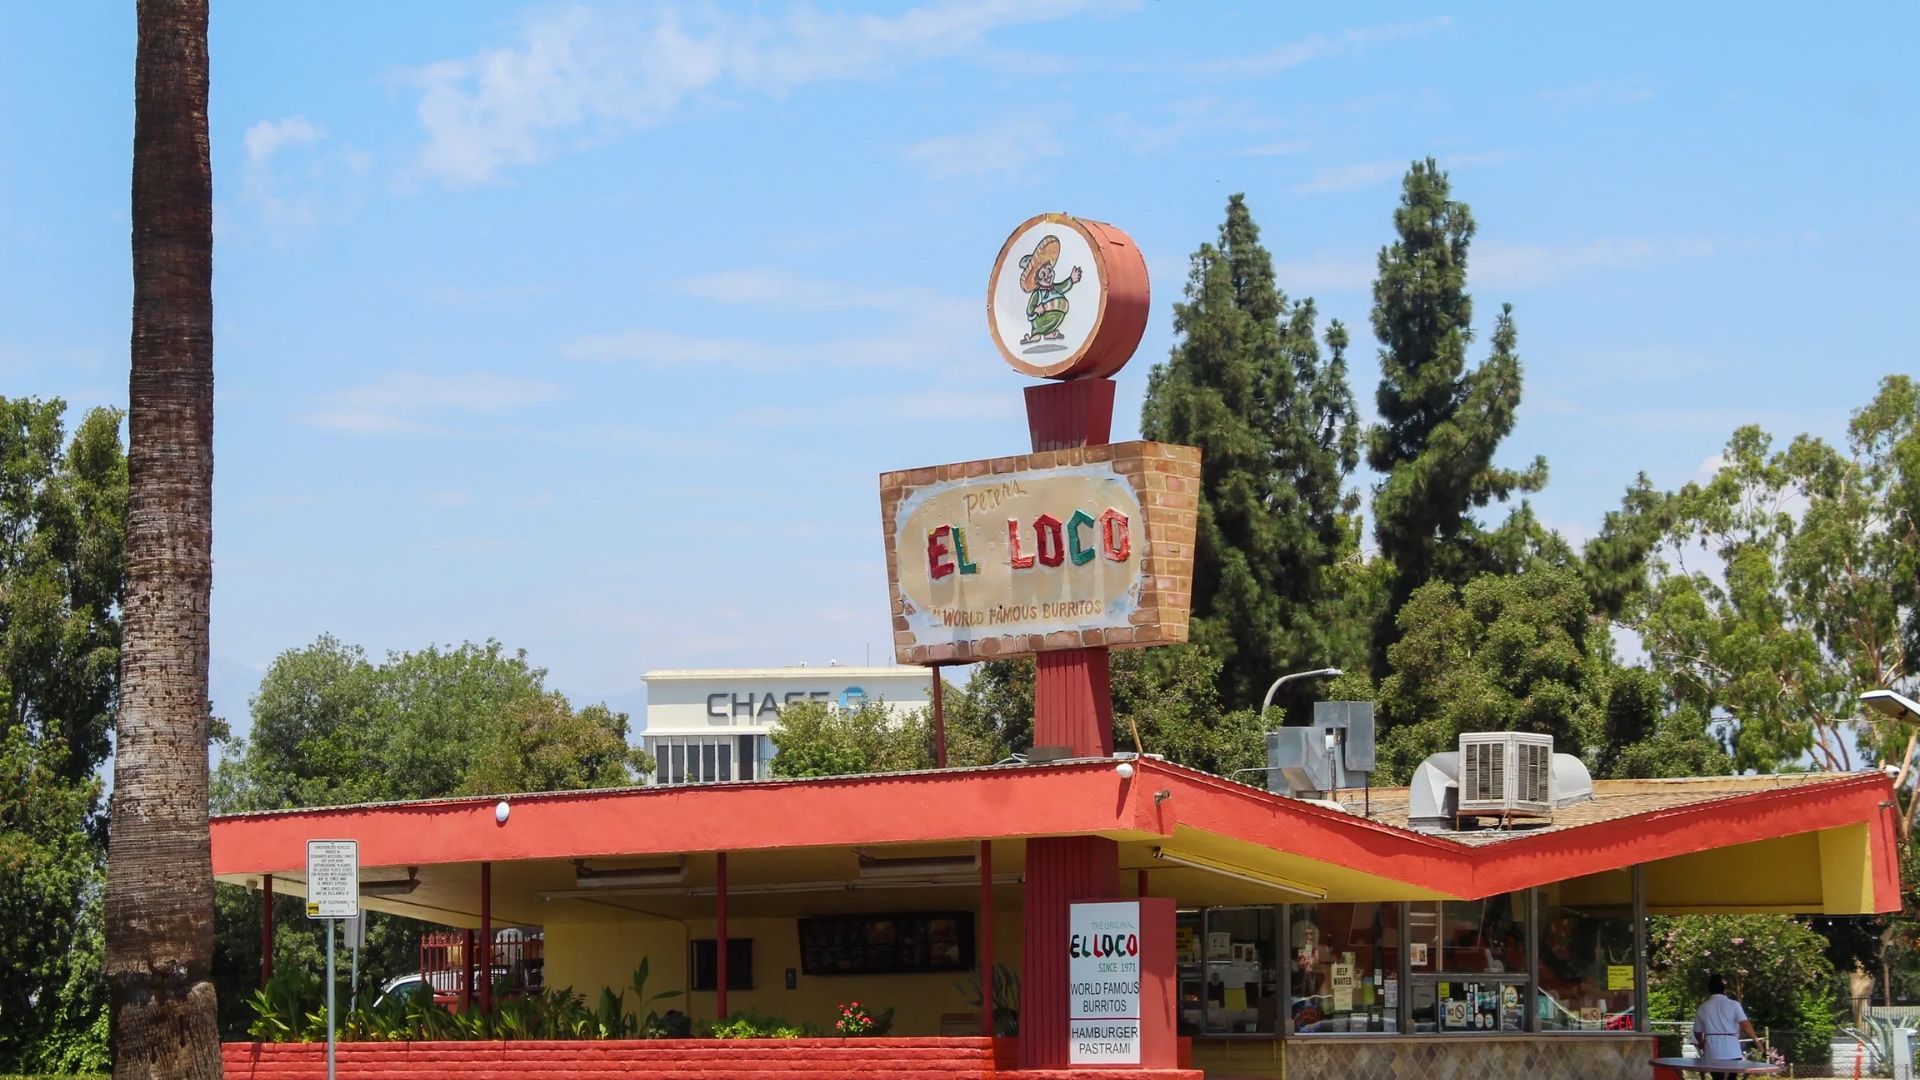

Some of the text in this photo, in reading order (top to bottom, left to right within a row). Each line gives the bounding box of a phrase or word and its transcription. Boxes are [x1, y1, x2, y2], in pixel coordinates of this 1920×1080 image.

[928, 507, 1131, 579] EL LOCO
[989, 605, 1037, 625] FAMOUS
[1043, 600, 1102, 619] BURRITOS
[1092, 921, 1135, 930] THE ORIGINAL
[1098, 962, 1136, 973] SINCE 1971
[1336, 967, 1349, 976] HELP
[1333, 976, 1352, 986] WANTED
[1071, 981, 1140, 996] WORLD FAMOUS
[1083, 999, 1127, 1013] BURRITOS
[1072, 1027, 1139, 1039] HAMBURGER
[1079, 1043, 1131, 1055] PASTRAMI
